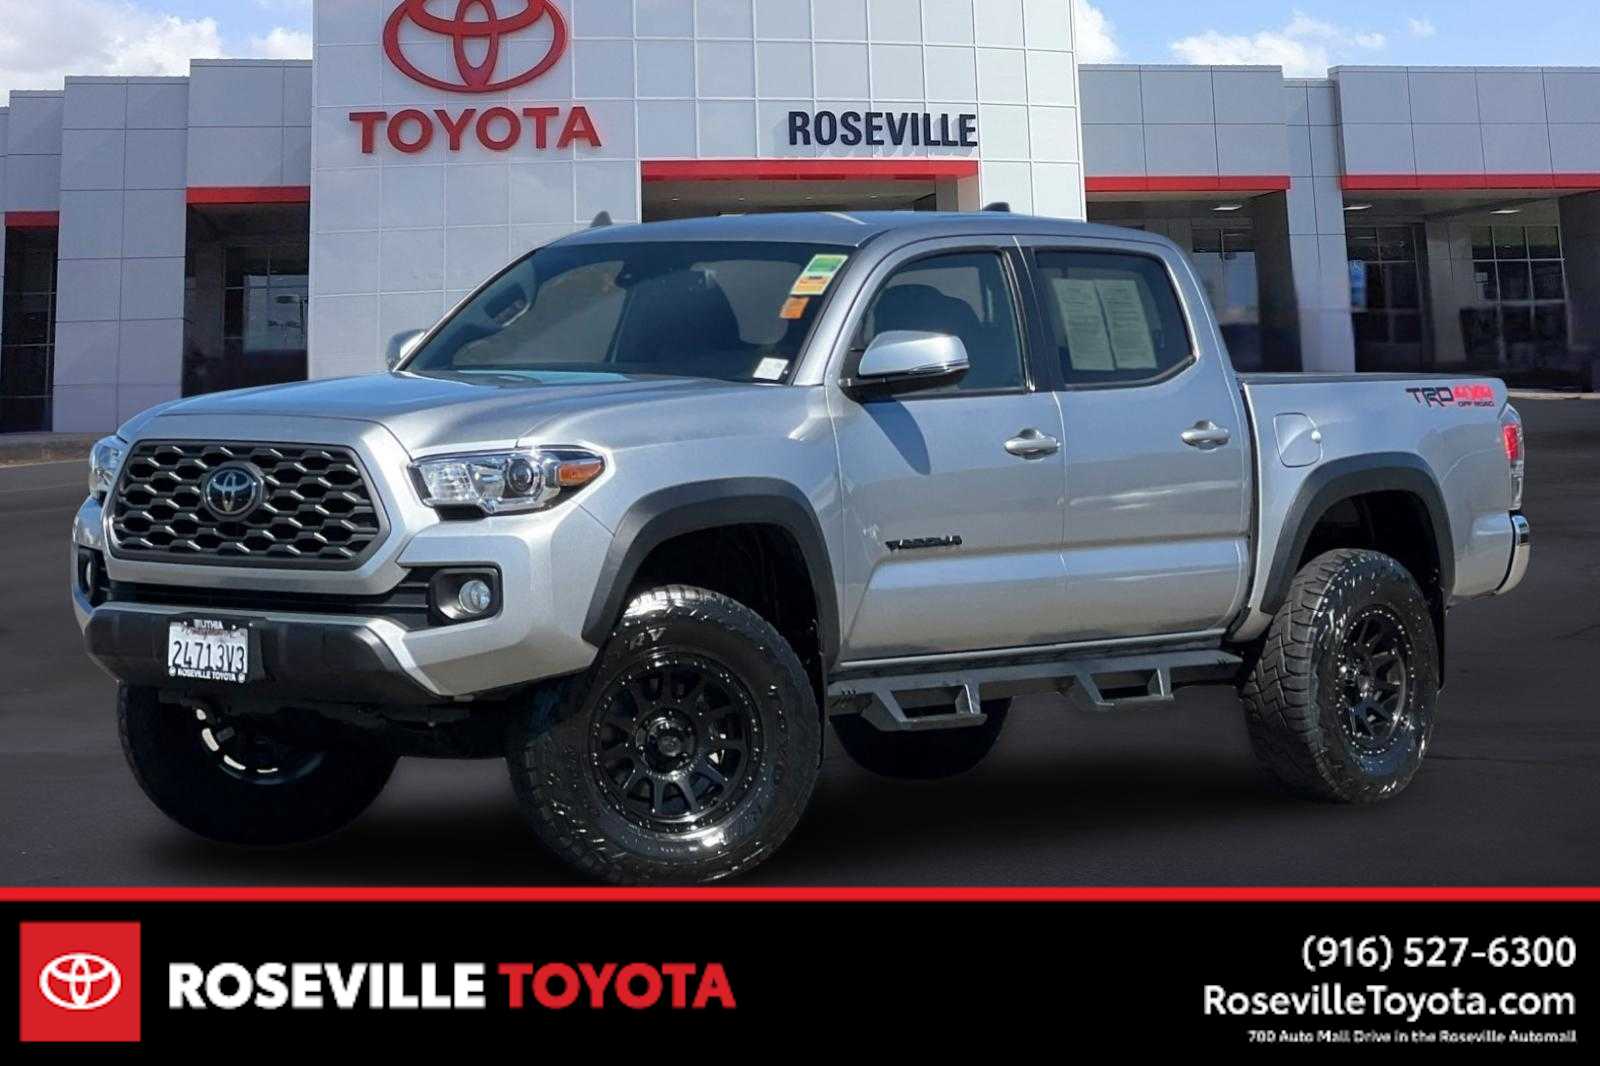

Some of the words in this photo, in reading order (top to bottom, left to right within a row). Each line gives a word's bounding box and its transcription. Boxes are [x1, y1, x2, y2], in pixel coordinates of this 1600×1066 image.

[349, 106, 603, 154] TOYOTA
[788, 110, 978, 148] ROSEVILLE
[1405, 387, 1455, 407] TRD
[172, 640, 245, 673] 24713V3
